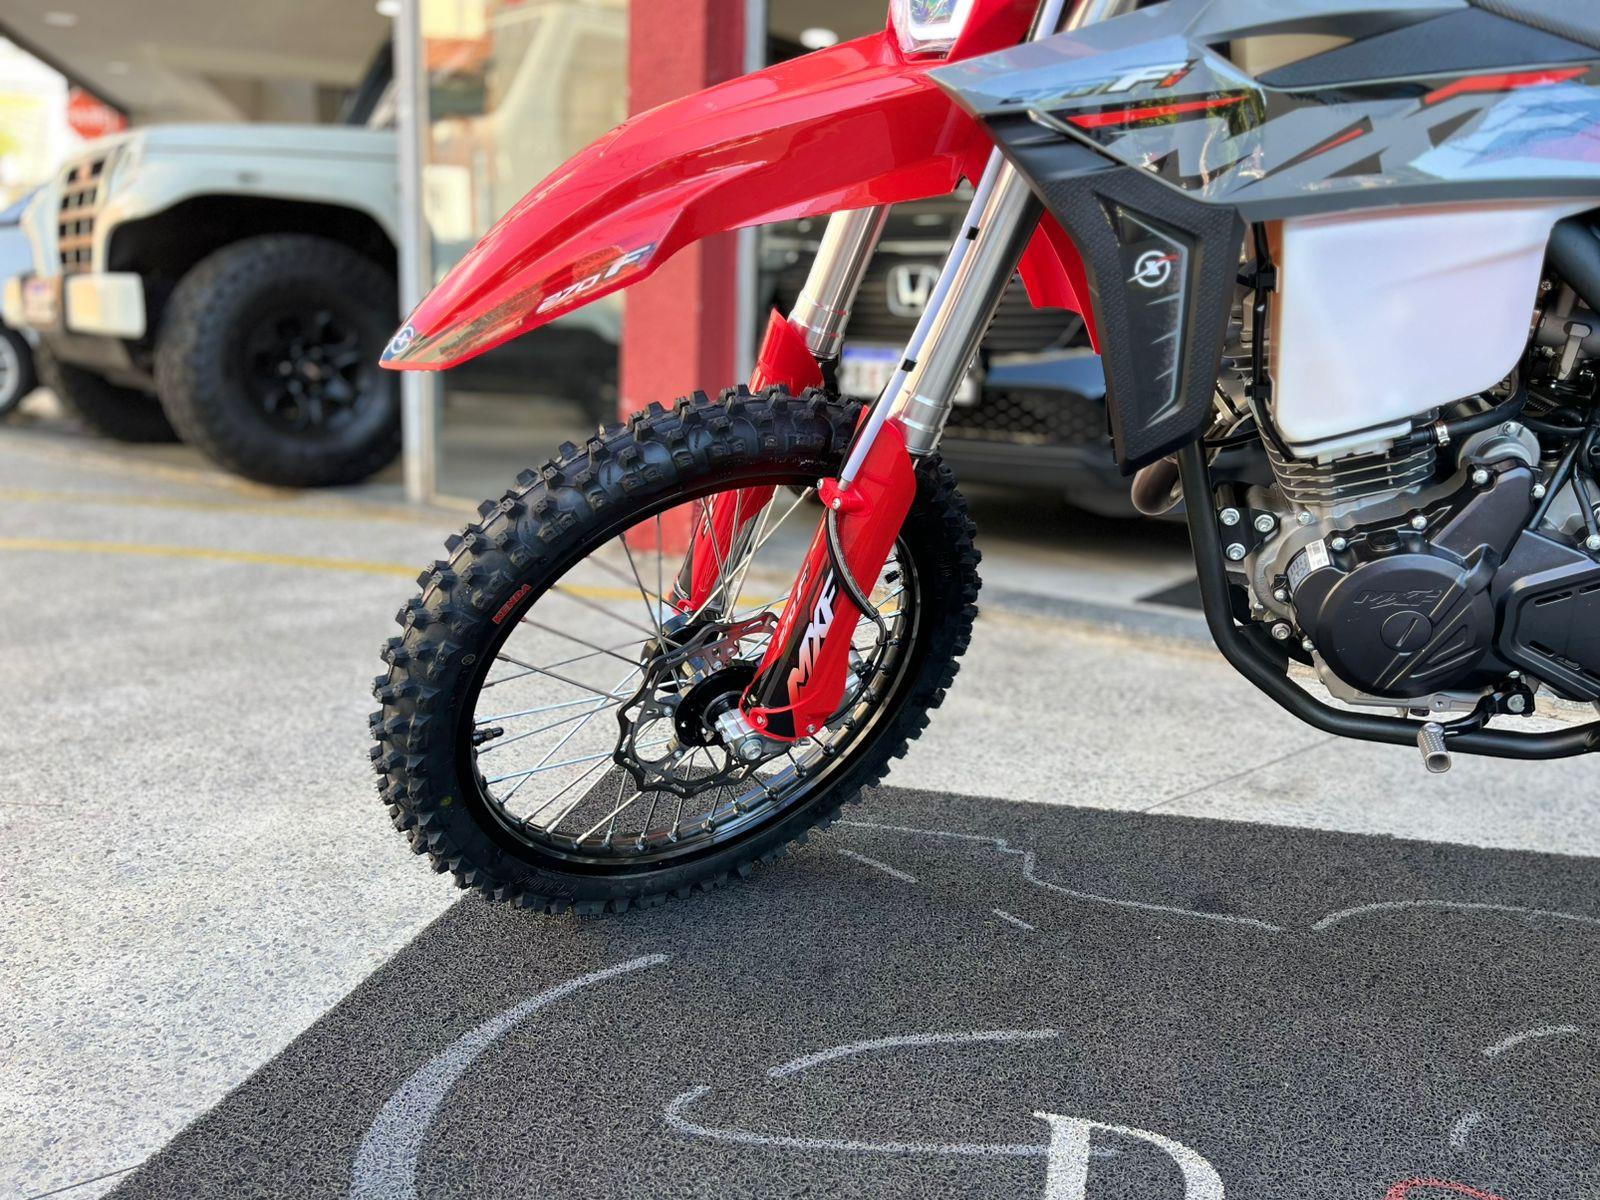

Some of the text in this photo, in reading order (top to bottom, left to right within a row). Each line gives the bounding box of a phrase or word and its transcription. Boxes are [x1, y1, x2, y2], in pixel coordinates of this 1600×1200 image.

[536, 273, 601, 314] 270
[492, 584, 532, 624] KENDA
[787, 568, 836, 706] MXF
